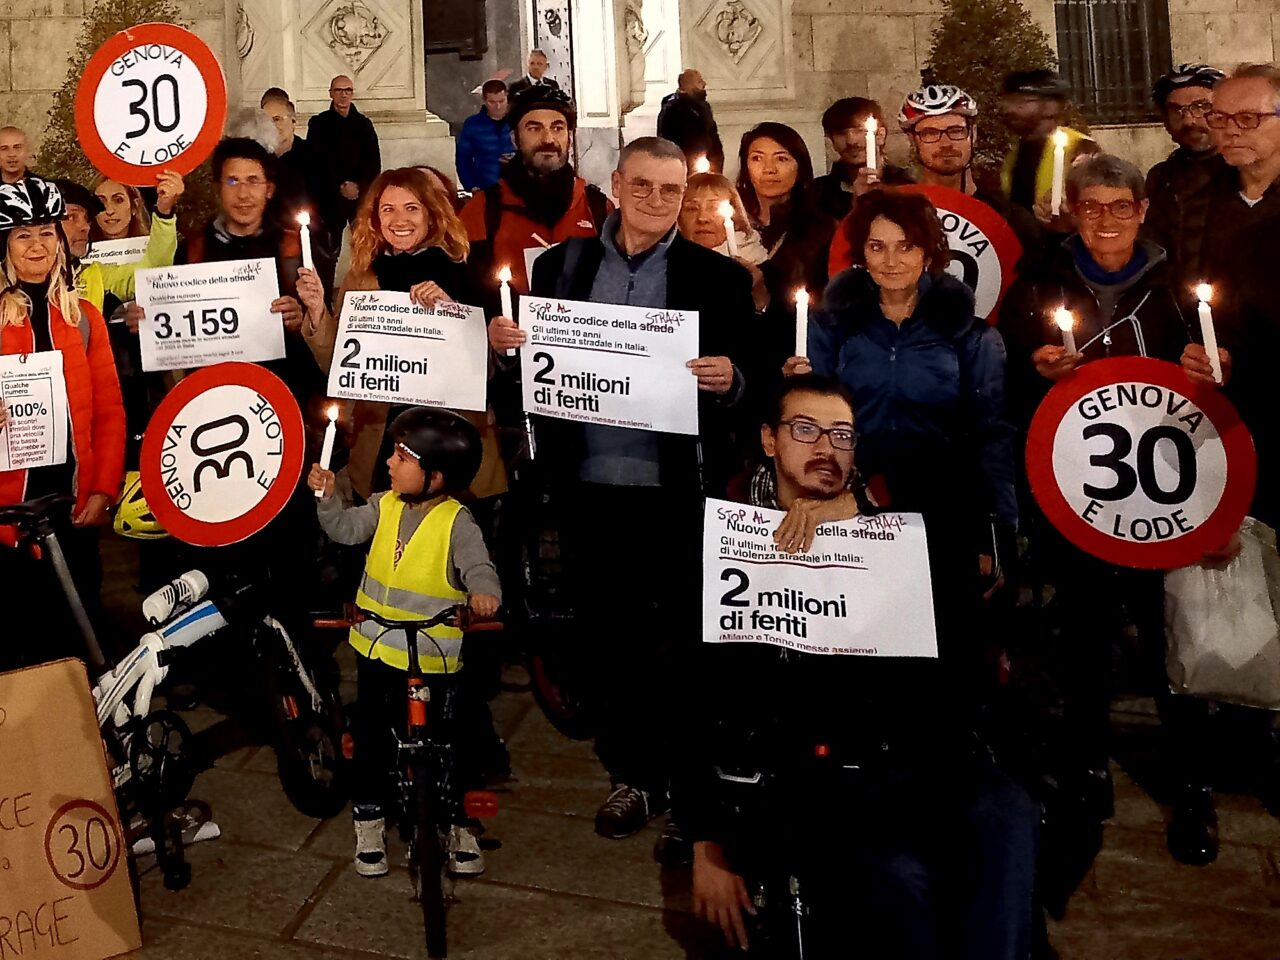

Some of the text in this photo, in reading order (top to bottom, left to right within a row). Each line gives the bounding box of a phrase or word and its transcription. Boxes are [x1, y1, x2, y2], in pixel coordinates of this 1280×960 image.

[111, 44, 183, 76] GENOVA
[122, 74, 180, 139] 30
[114, 134, 192, 164] E LODE
[942, 214, 989, 257] OVA
[152, 281, 178, 290] Nuovo
[181, 278, 206, 286] codice
[209, 275, 228, 284] della
[354, 303, 378, 311] Nuovo
[379, 304, 410, 314] codice
[529, 302, 571, 313] STOP AL
[645, 312, 685, 326] STRAGE
[154, 308, 238, 339] 3.159
[383, 324, 412, 332] stradale
[423, 327, 443, 335] Italia:
[537, 311, 570, 323] Nuovo
[573, 316, 608, 327] codice
[612, 320, 637, 330] della
[546, 327, 569, 335] ultimi
[571, 329, 580, 337] 10
[542, 335, 576, 344] violenza
[579, 339, 612, 347] stradale
[614, 341, 622, 349] in
[625, 343, 648, 352] Italia:
[340, 338, 428, 375] 2 milioni
[339, 372, 400, 392] di feriti
[533, 352, 630, 395] 2 milioni
[7, 402, 47, 417] 100%
[534, 388, 599, 412] di feriti
[1078, 385, 1205, 433] GENOVA
[191, 414, 254, 493] 30
[249, 394, 283, 491] E LODE
[161, 425, 191, 510] GENOVA
[1083, 422, 1197, 505] 30
[717, 508, 770, 524] STOP AL
[857, 515, 907, 532] STRAGE
[1082, 500, 1194, 541] E LODE
[727, 519, 769, 537] Nuovo
[816, 525, 847, 538] della
[720, 536, 767, 551] Gli ultimi
[720, 547, 730, 556] di
[733, 548, 776, 560] violenza
[779, 553, 820, 563] stradale
[823, 553, 831, 562] in
[834, 553, 864, 563] Italia:
[720, 568, 847, 618] 2 milioni
[720, 610, 807, 638] di feriti
[764, 633, 794, 648] Torino
[797, 642, 829, 654] messe
[58, 817, 111, 878] 30
